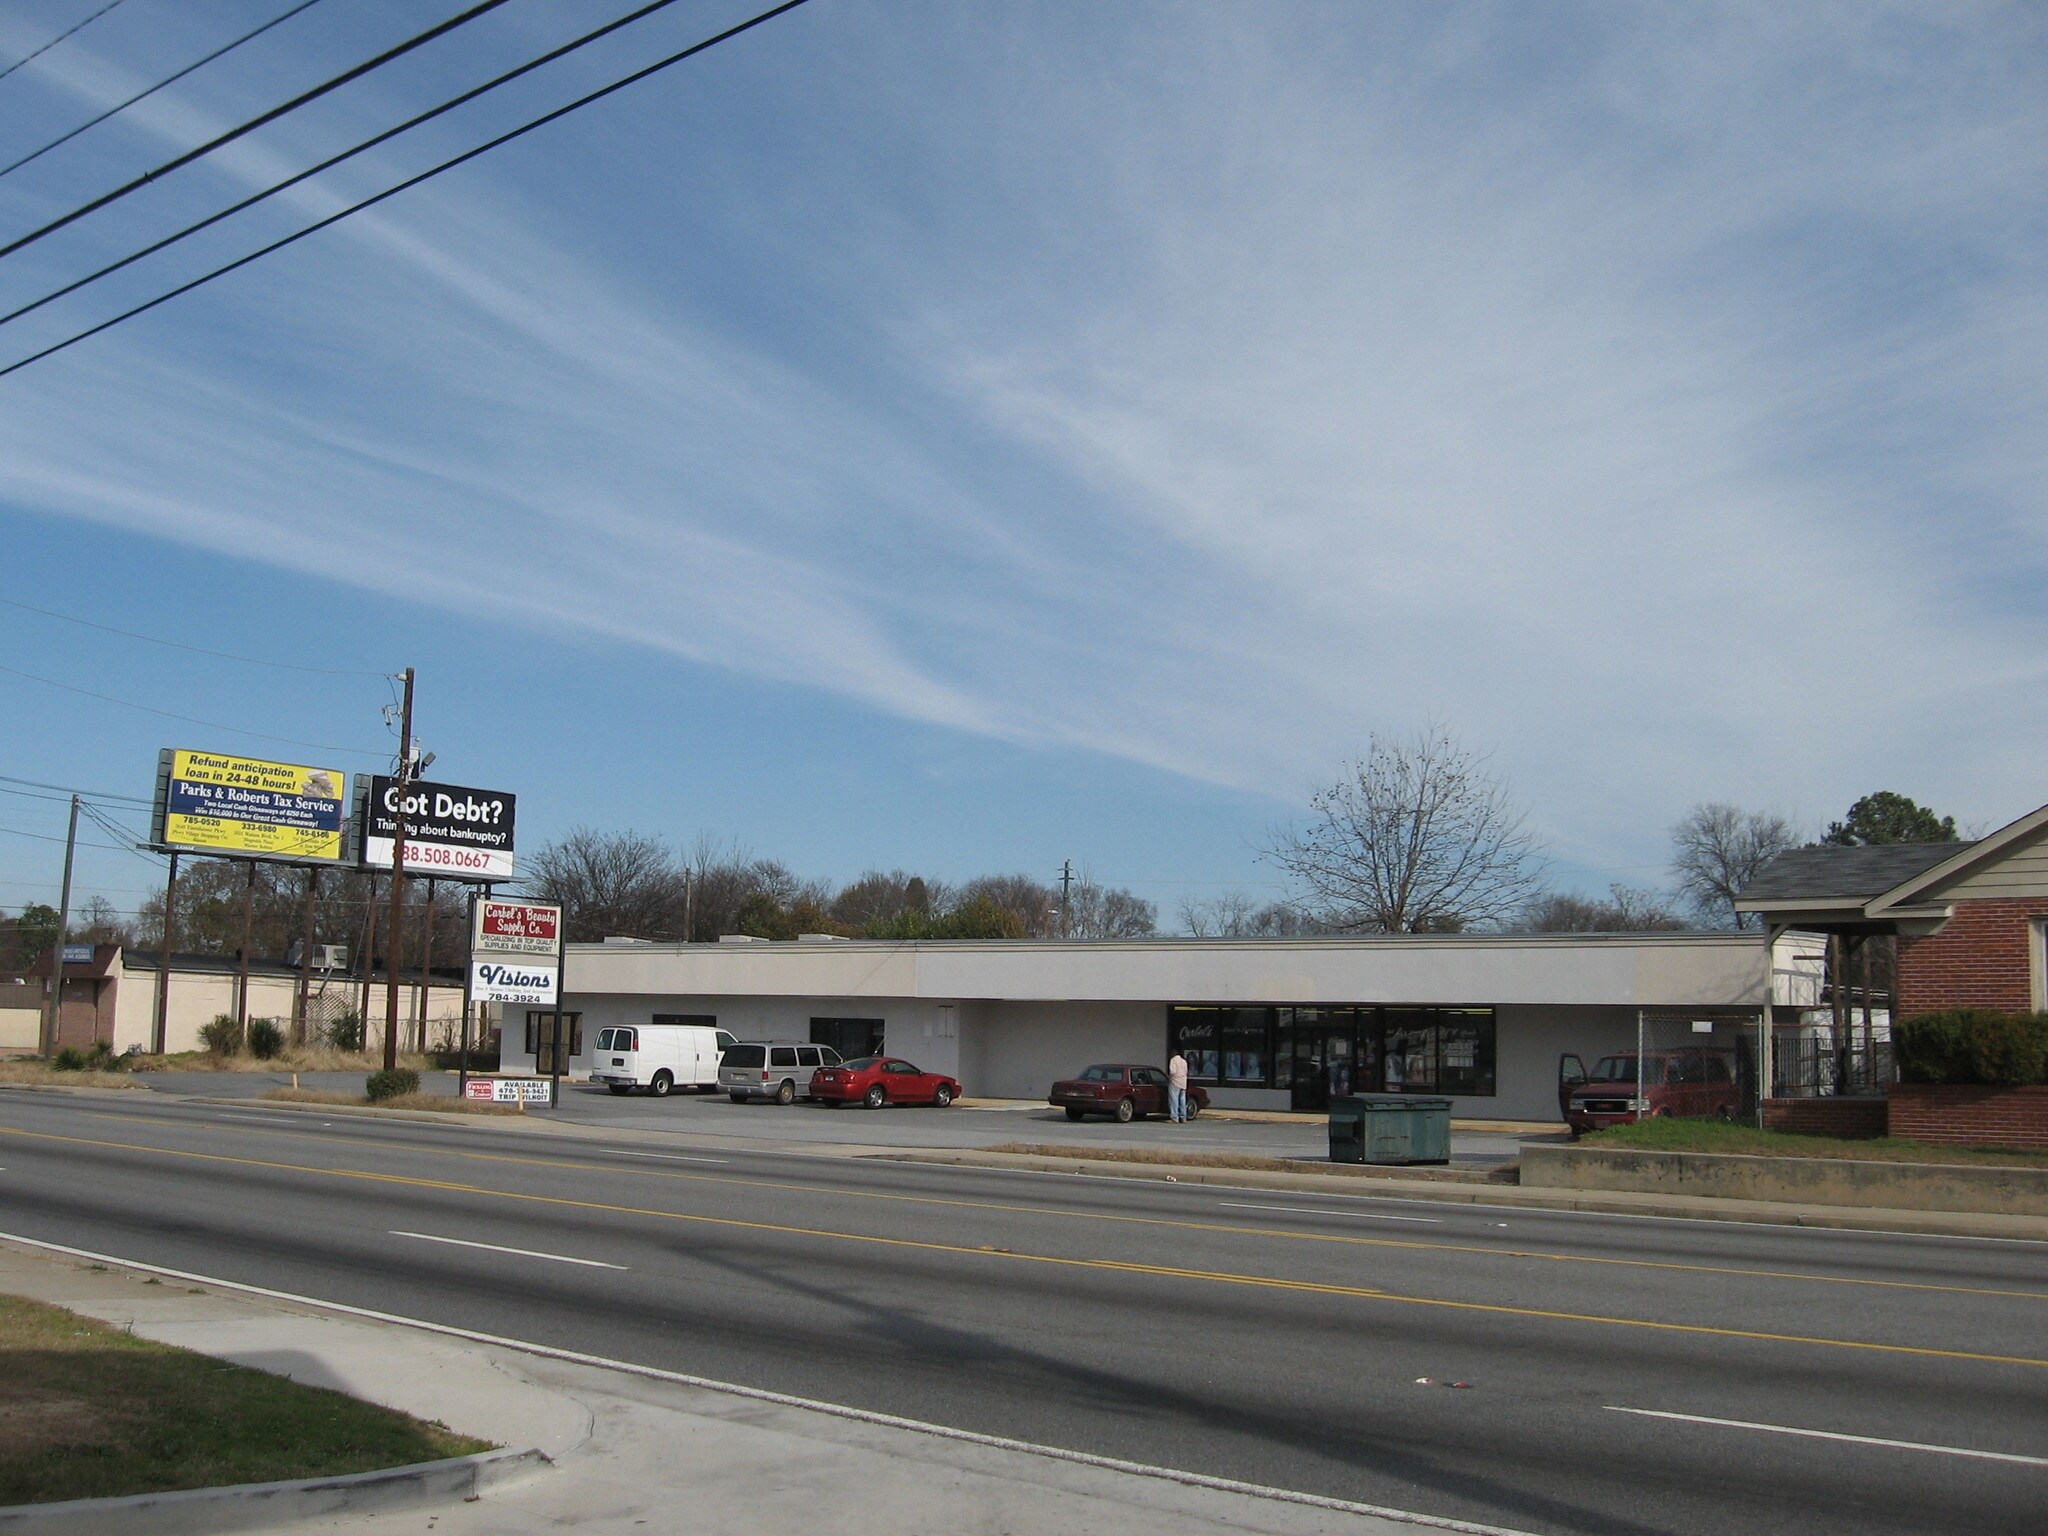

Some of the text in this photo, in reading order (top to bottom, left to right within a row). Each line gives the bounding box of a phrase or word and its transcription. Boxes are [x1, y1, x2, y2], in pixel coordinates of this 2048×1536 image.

[189, 755, 294, 778] Refund anticipation
[185, 767, 297, 790] loan in 24-48 hours!
[179, 782, 335, 813] Parks & Roberts Tax Service
[383, 786, 503, 825] Got Debt?
[217, 801, 233, 809] Local
[233, 803, 248, 811] Cash
[248, 805, 279, 815] Giveaways
[183, 815, 221, 827] 785-0520
[252, 813, 270, 822] Great
[270, 815, 286, 823] Cash
[241, 823, 277, 833] 333-6980
[376, 817, 507, 845] Thinng about bankruptcy?
[402, 845, 491, 869] 88.508.0667
[525, 908, 556, 927] Beauty
[496, 918, 543, 936] Supply Co.
[480, 933, 516, 944] SPECIALIZING
[536, 938, 557, 946] QUALITY
[484, 941, 553, 953] SUPPLIES AND EQUIPMENT
[479, 964, 550, 988] Visions
[488, 992, 541, 1004] 784-3924
[498, 1087, 548, 1095] 478-6-9421
[504, 1081, 544, 1089] AVAILABLE
